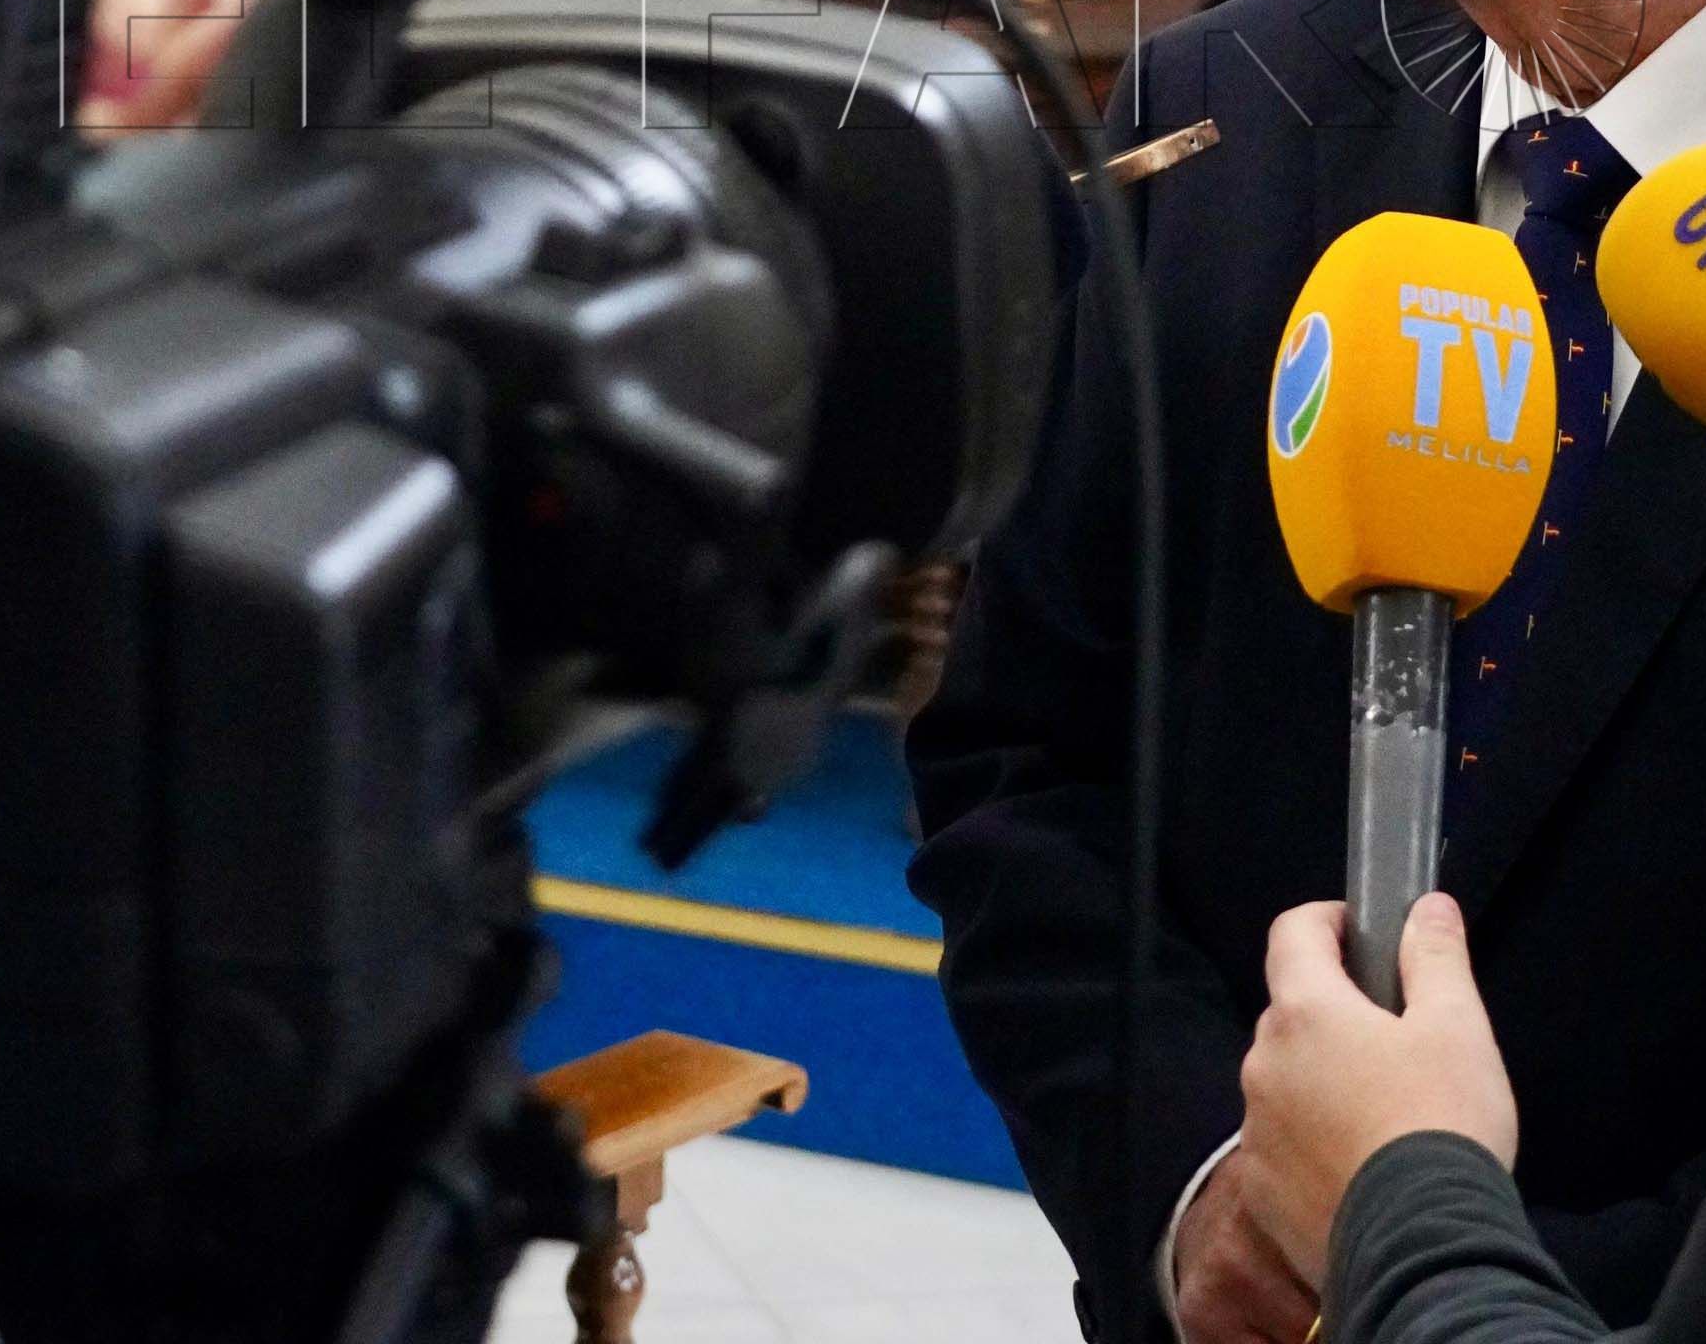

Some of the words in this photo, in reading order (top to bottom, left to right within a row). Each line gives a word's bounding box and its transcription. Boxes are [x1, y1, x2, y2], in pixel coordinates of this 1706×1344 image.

[1399, 283, 1533, 338] POPULAR
[1400, 315, 1534, 444] TV
[1386, 430, 1531, 475] MELILLA
